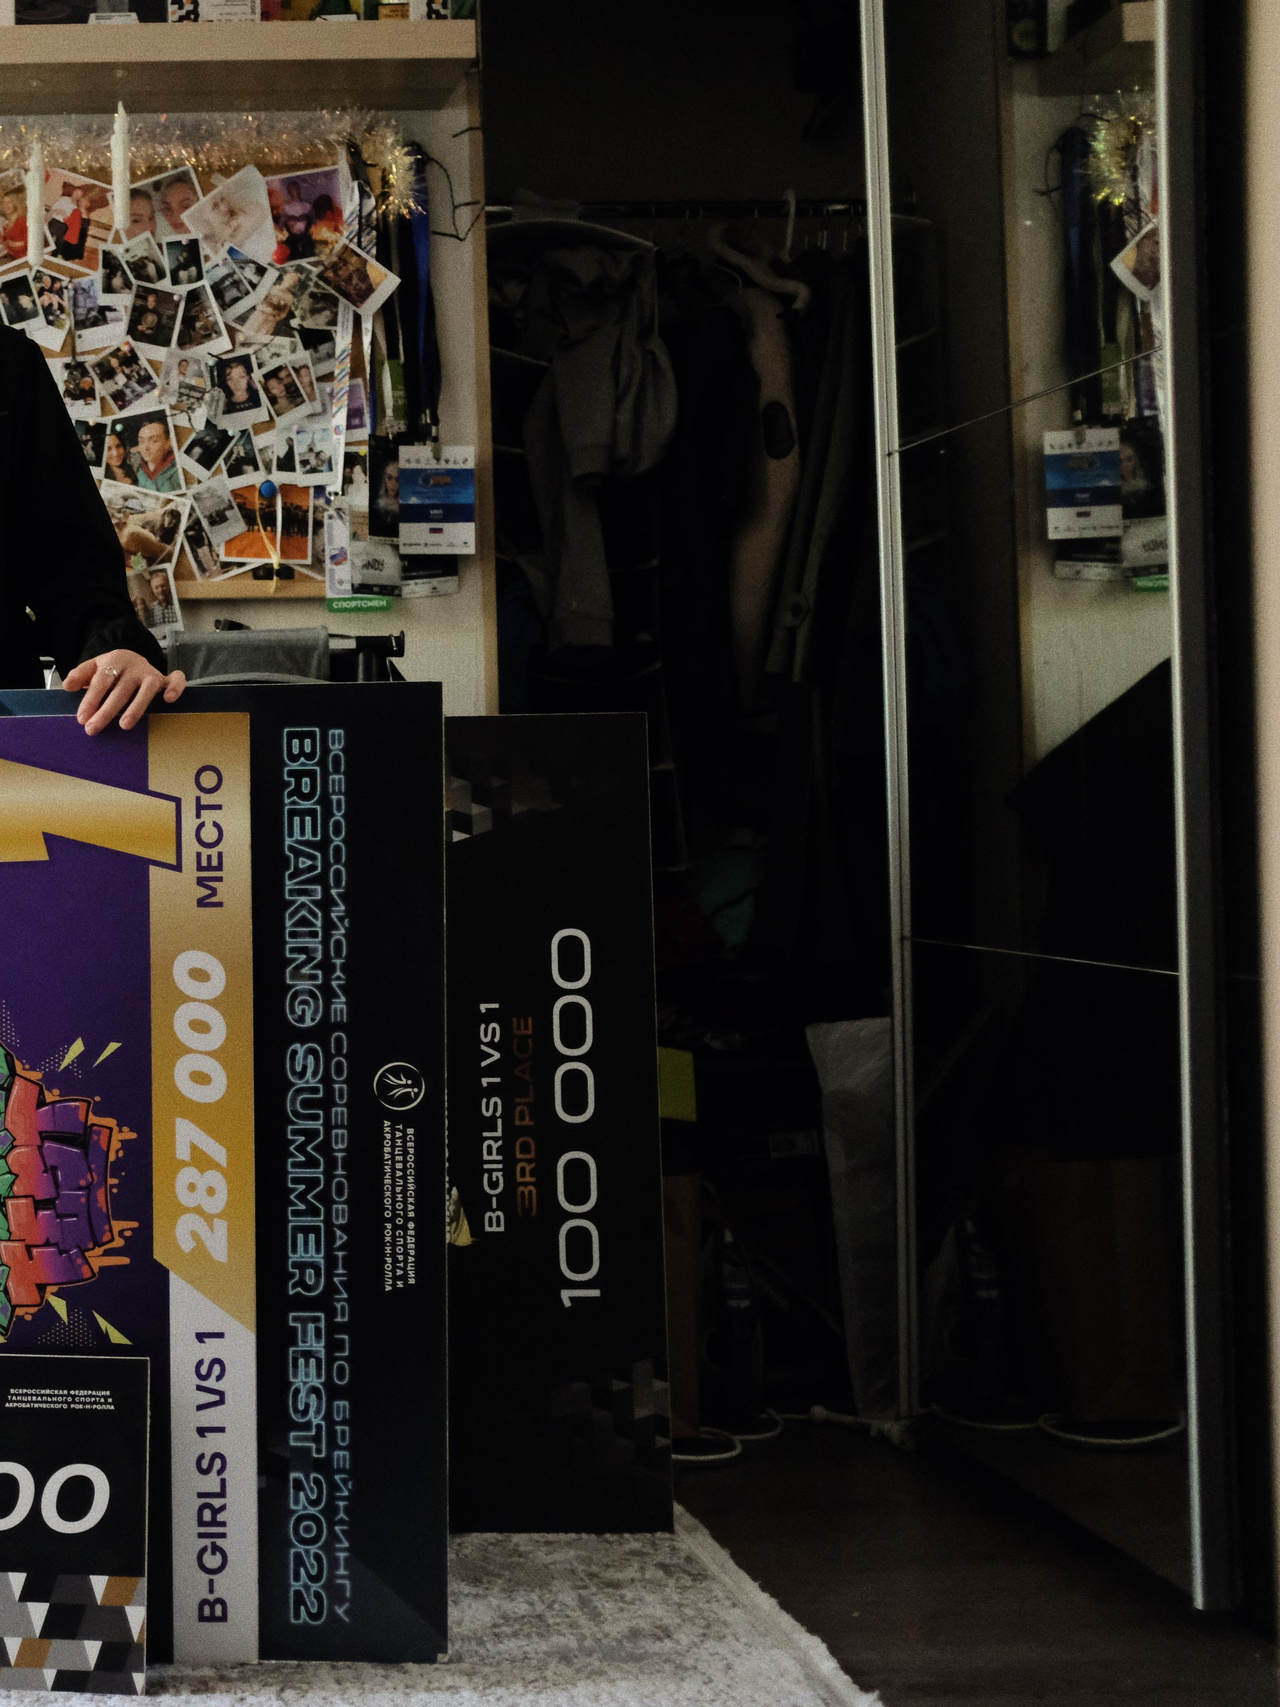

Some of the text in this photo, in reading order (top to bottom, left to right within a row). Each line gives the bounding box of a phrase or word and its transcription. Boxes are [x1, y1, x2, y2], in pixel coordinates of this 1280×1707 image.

[333, 599, 386, 609] СПОРТСМЕН
[194, 763, 226, 909] МЕСТО
[170, 948, 230, 1263] 287 000
[283, 727, 326, 1626] BREAKING SUMMER FEST 2022
[328, 728, 355, 1624] ВСЕРОССИЙСКИЕ СОРЕВНОВАНИЯ ПО БРЕЙКИНГУ
[383, 1120, 392, 1218] АКРОБАТИЧЕСКОГО
[394, 1124, 404, 1225] ТАНЦЕВАЛЬНОГО
[406, 1128, 416, 1284] ВСЕРОССИЙСКАЯ ФЕДЕРАЦИЯ
[478, 1001, 506, 1233] B-GIRLS 1 VS 1
[511, 1016, 539, 1218] 3RD PLACE
[550, 926, 603, 1309] 100 000
[395, 1230, 403, 1275] СПОРТА
[194, 1330, 230, 1625] B-GIRLS 1 VS 1
